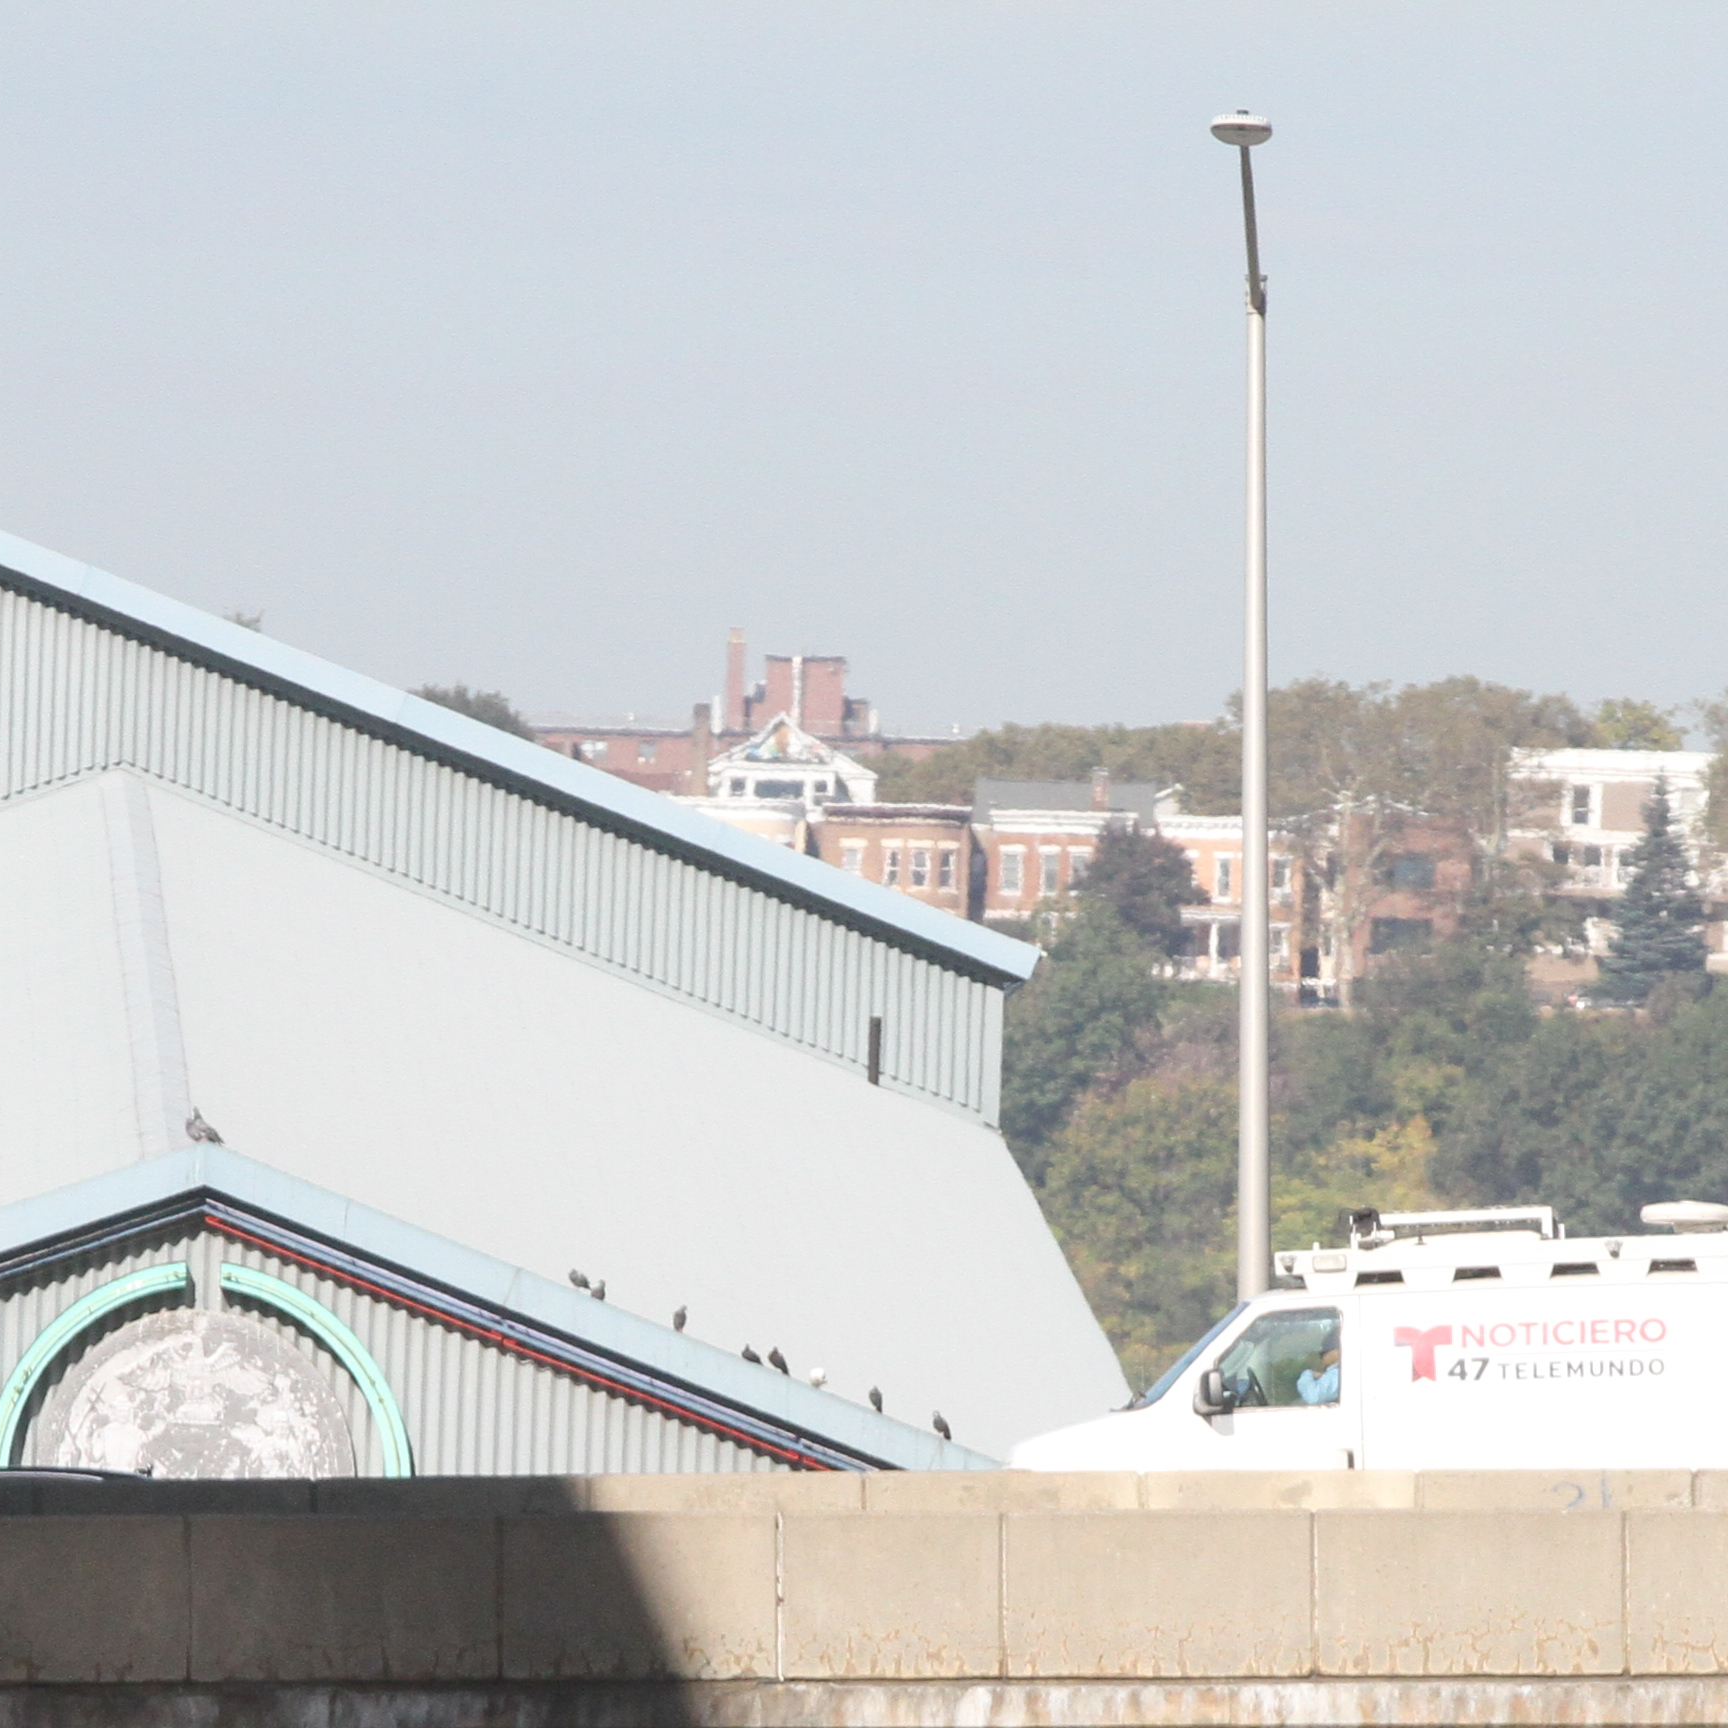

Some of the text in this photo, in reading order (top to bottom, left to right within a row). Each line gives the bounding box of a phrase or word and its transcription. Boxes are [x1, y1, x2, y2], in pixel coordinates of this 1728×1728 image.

[1461, 1317, 1667, 1349] NOTICIERO
[1447, 1356, 1665, 1382] 47 TELEMUNDO
